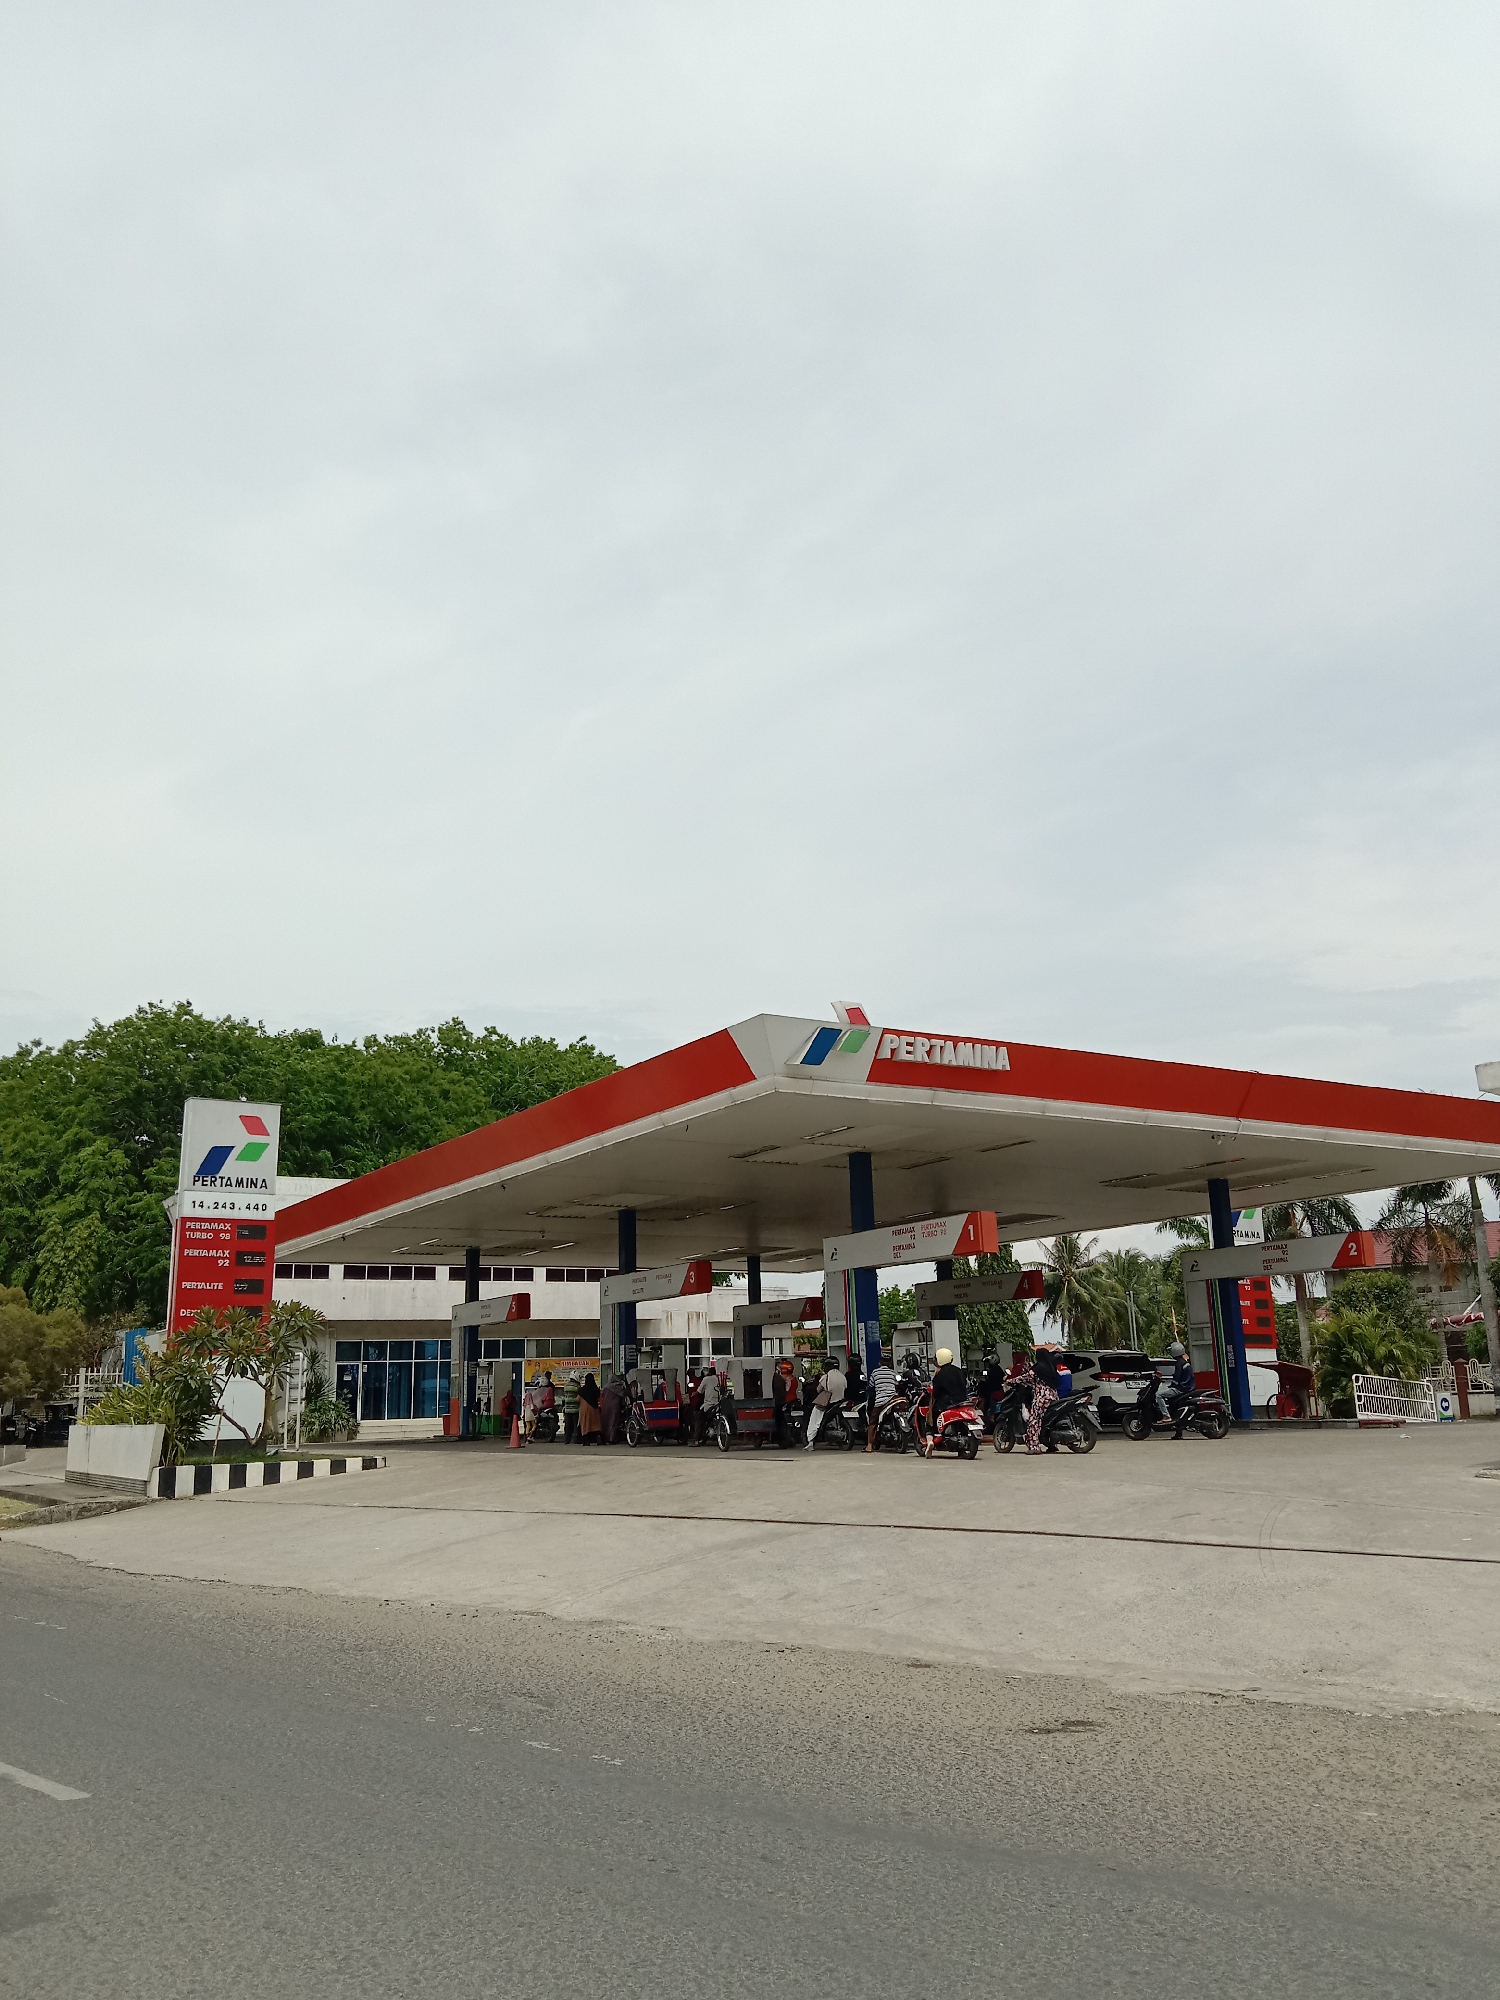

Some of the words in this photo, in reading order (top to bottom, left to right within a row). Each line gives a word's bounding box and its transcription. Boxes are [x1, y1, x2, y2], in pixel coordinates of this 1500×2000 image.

[877, 1034, 1011, 1071] PERTAMINA
[192, 1175, 268, 1190] PERTAMINA
[185, 1221, 232, 1231] PERTAMAX
[185, 1231, 214, 1240] TURBO
[219, 1233, 231, 1241] 98
[892, 1226, 916, 1237] PERTAMAX
[967, 1224, 975, 1241] 1
[1232, 1230, 1261, 1239] RTAMINA
[1261, 1243, 1288, 1252] PERTAMAX
[1348, 1242, 1358, 1256] 2
[184, 1249, 231, 1258] PERTAMAX
[217, 1259, 230, 1267] 92
[689, 1271, 695, 1284] 3
[181, 1281, 224, 1290] PERTALITE
[1023, 1278, 1029, 1290] 4
[511, 1301, 516, 1313] 5
[805, 1303, 811, 1313] 6
